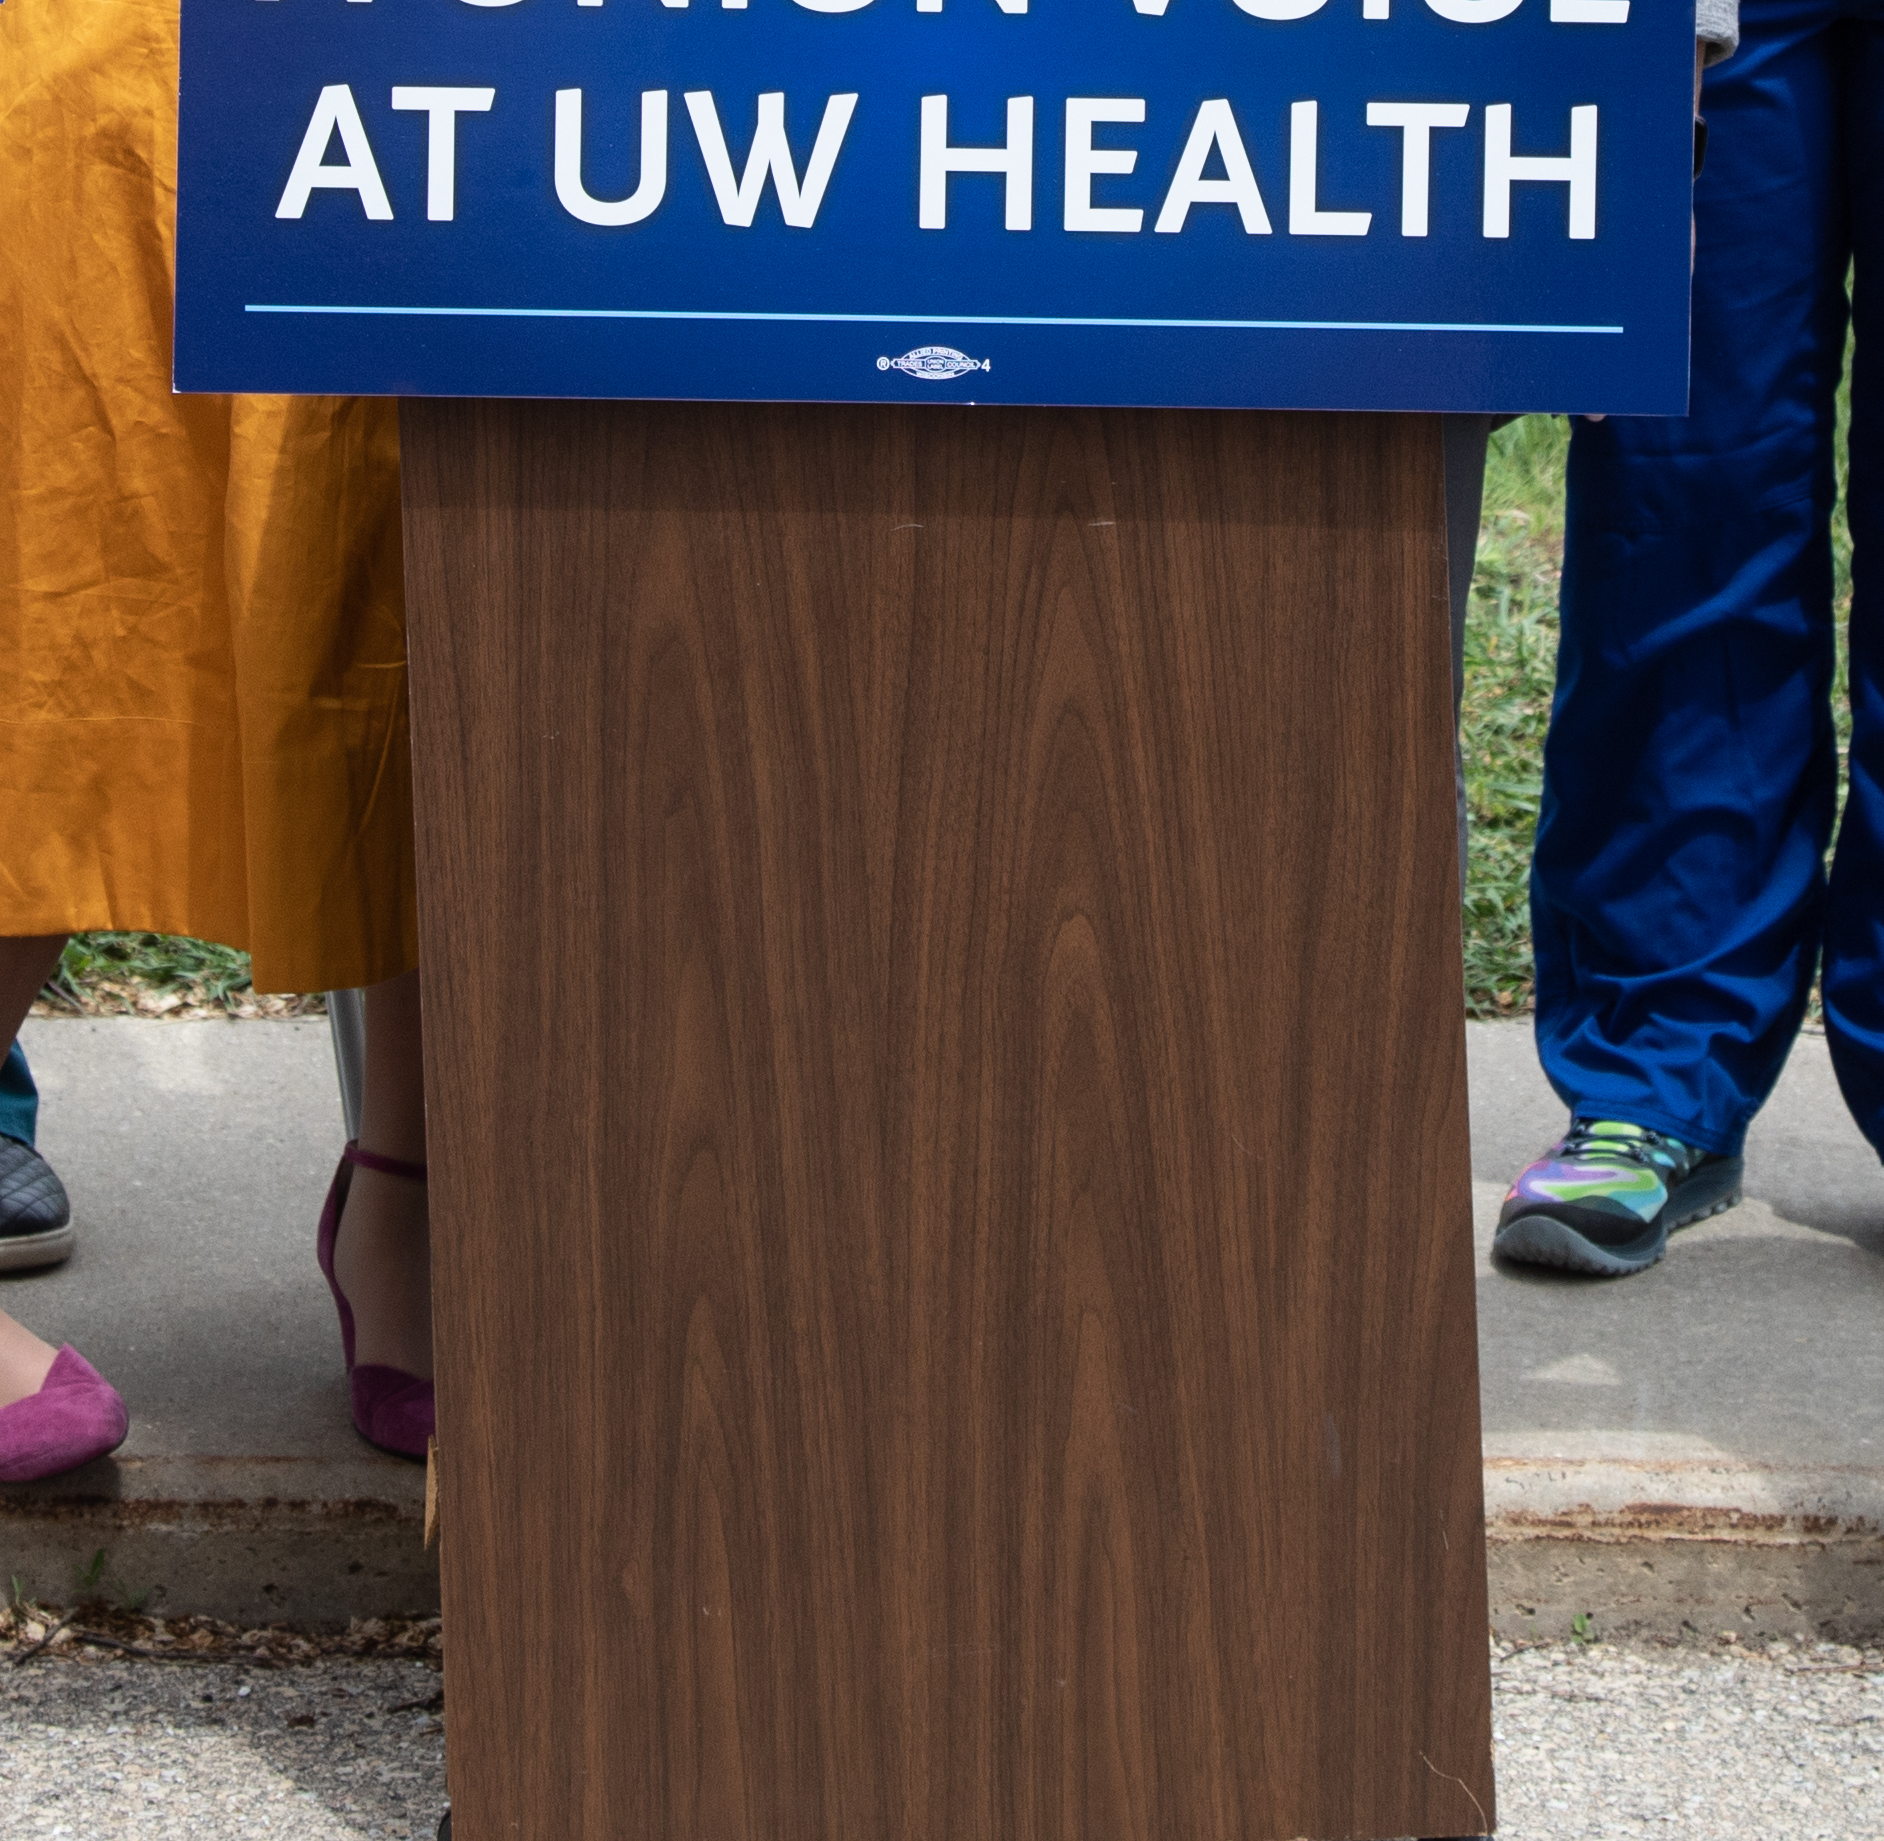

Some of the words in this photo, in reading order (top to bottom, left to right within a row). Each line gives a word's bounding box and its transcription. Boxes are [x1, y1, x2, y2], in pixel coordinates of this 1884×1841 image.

[275, 83, 495, 223] AT
[552, 88, 859, 230] UW
[918, 94, 1599, 241] HEALTH
[981, 359, 991, 373] 4
